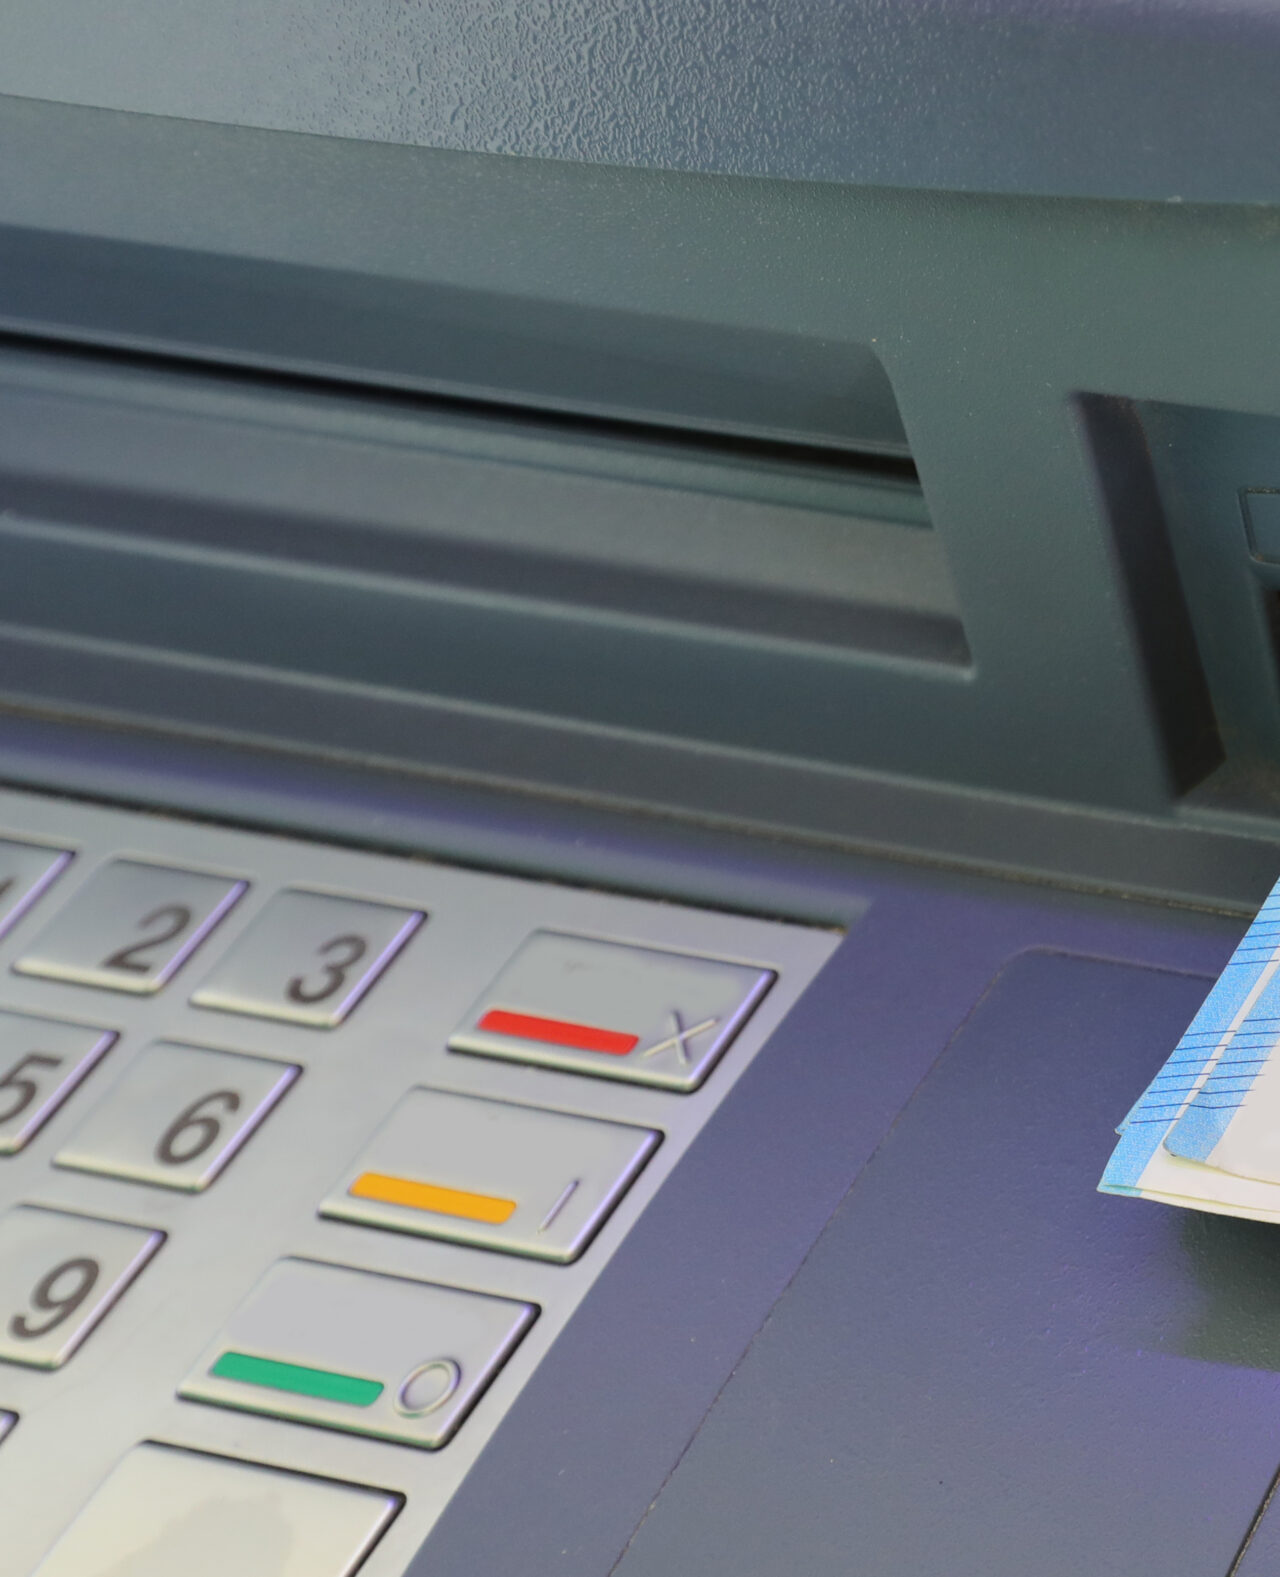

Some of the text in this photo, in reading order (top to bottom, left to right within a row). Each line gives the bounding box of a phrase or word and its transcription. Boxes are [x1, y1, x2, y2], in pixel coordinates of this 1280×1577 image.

[101, 904, 191, 974] 2
[286, 935, 367, 1003] 3
[0, 1052, 63, 1124] 5
[156, 1090, 241, 1168] 6
[9, 1257, 100, 1340] 9
